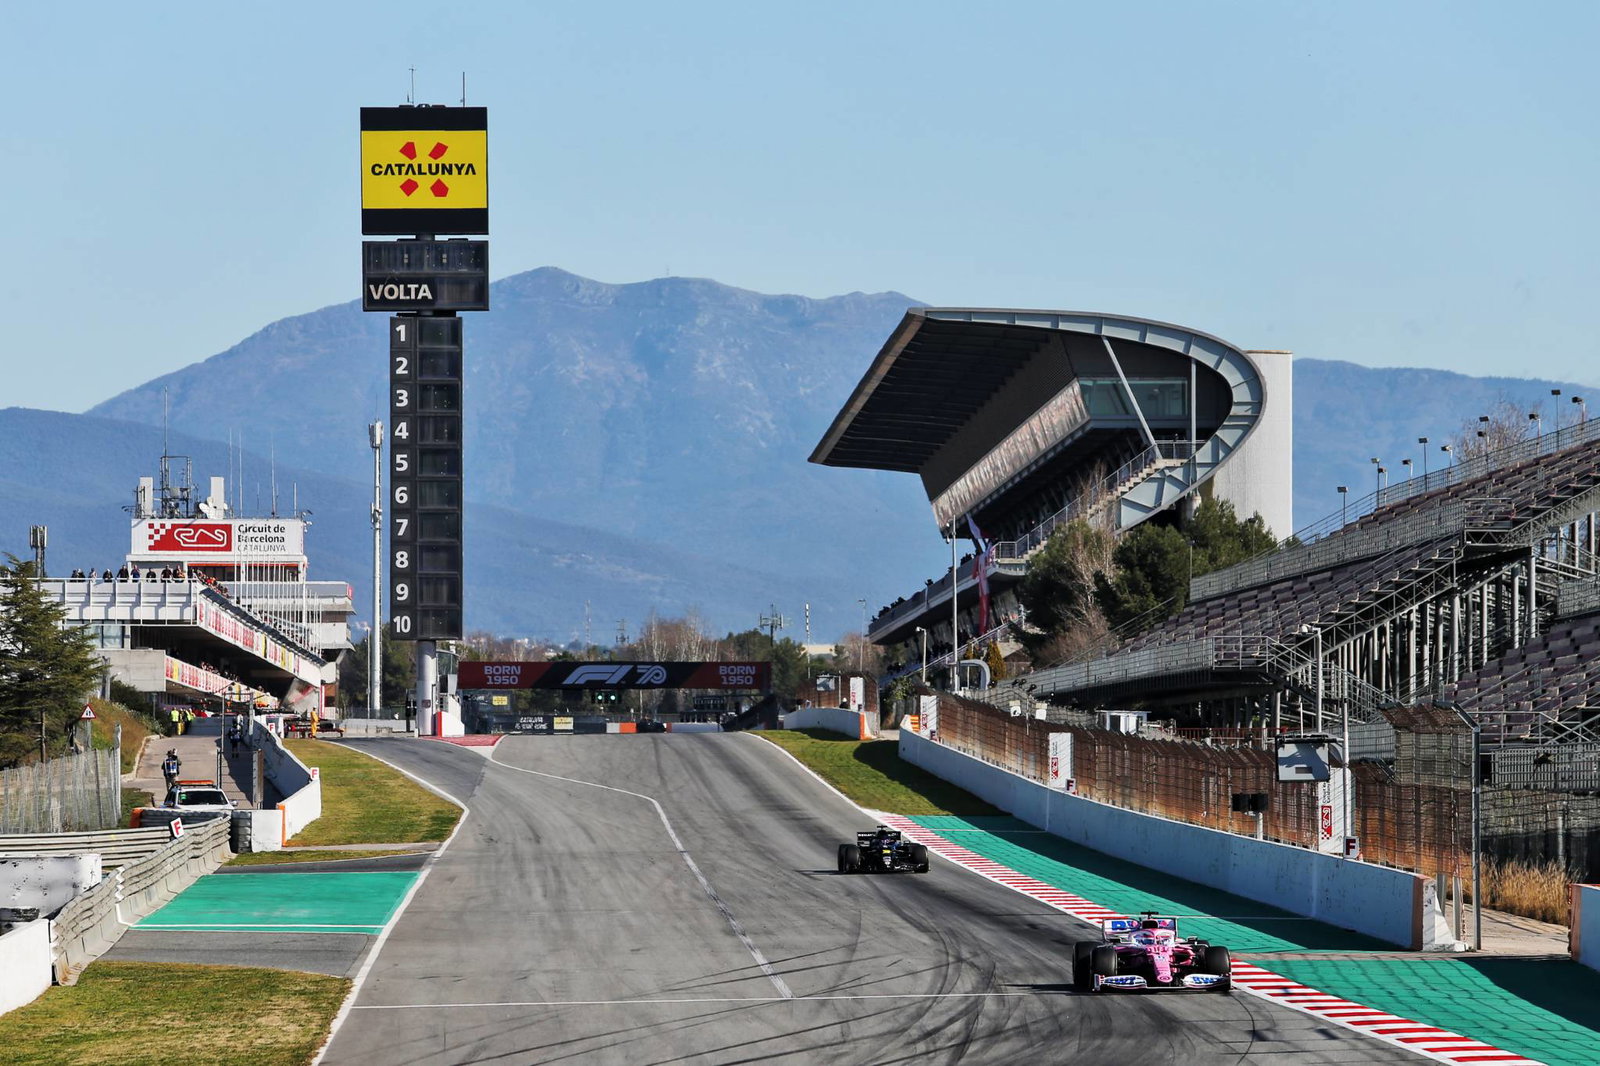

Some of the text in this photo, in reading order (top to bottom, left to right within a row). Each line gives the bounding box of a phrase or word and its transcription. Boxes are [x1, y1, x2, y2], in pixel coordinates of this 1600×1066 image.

[371, 163, 476, 175] CATALUNYA
[369, 284, 433, 300] VOLTA
[396, 325, 406, 341] 1
[396, 357, 408, 374] 2
[396, 390, 408, 407] 3
[395, 422, 409, 439] 4
[396, 454, 408, 471] 5
[395, 487, 408, 504] 6
[238, 524, 286, 533] Circuit de
[396, 519, 408, 536] 7
[237, 534, 285, 543] Barcelona
[237, 544, 286, 552] CATALUNYA
[395, 551, 408, 568] 8
[396, 584, 408, 601] 9
[393, 616, 411, 633] 10
[484, 665, 521, 675] BORN
[719, 665, 756, 675] BORN
[486, 676, 519, 685] 1950
[721, 676, 753, 685] 1950
[269, 724, 275, 732] F
[311, 769, 318, 778] F
[1066, 779, 1074, 791] F
[173, 820, 181, 835] F
[1345, 838, 1356, 856] F
